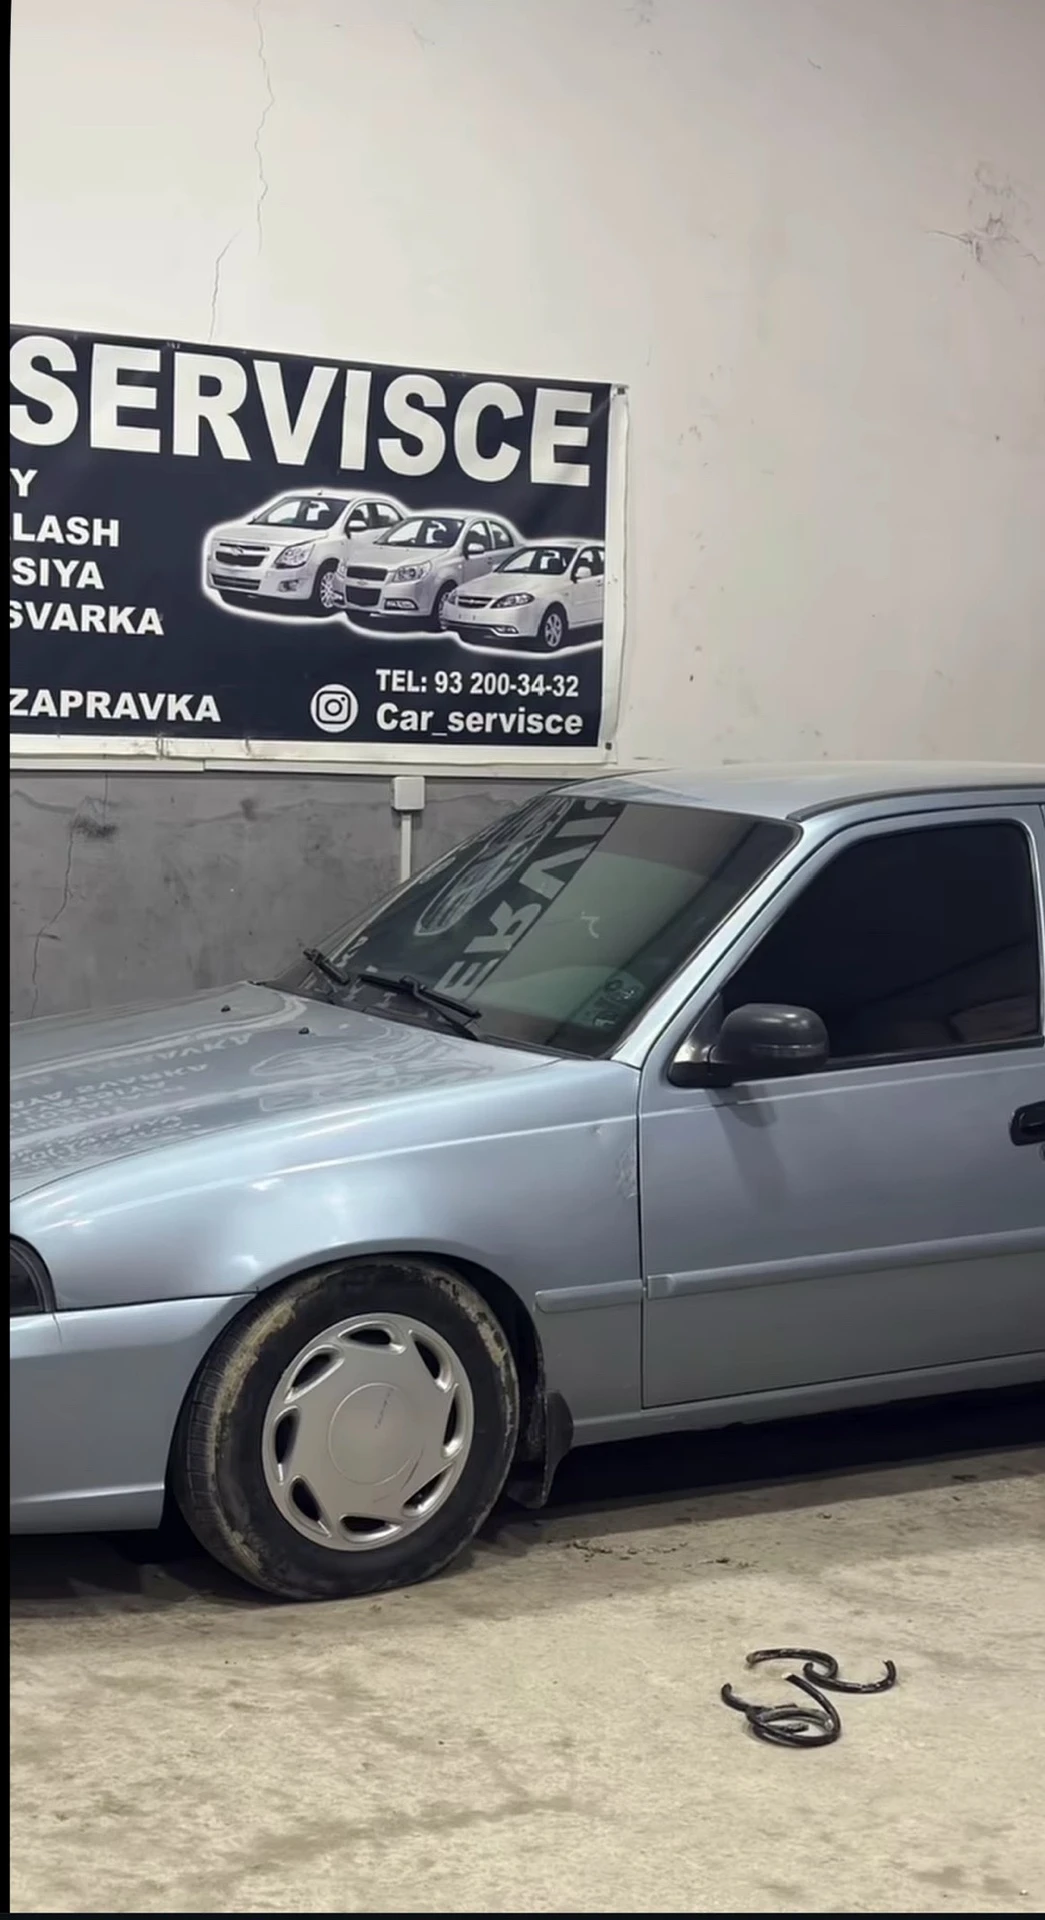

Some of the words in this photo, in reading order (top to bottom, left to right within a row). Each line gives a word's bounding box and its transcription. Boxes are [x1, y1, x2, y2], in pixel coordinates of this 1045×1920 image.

[10, 335, 593, 487] SERVISCE
[10, 512, 119, 548] LASH
[11, 556, 105, 590] SIYA
[10, 599, 165, 636] SVARKA
[375, 668, 428, 693] TEL:
[434, 670, 463, 694] 93
[469, 671, 580, 697] 200-34-32
[10, 687, 221, 722] ZAPRAVKA
[376, 702, 584, 736] Car_servisce
